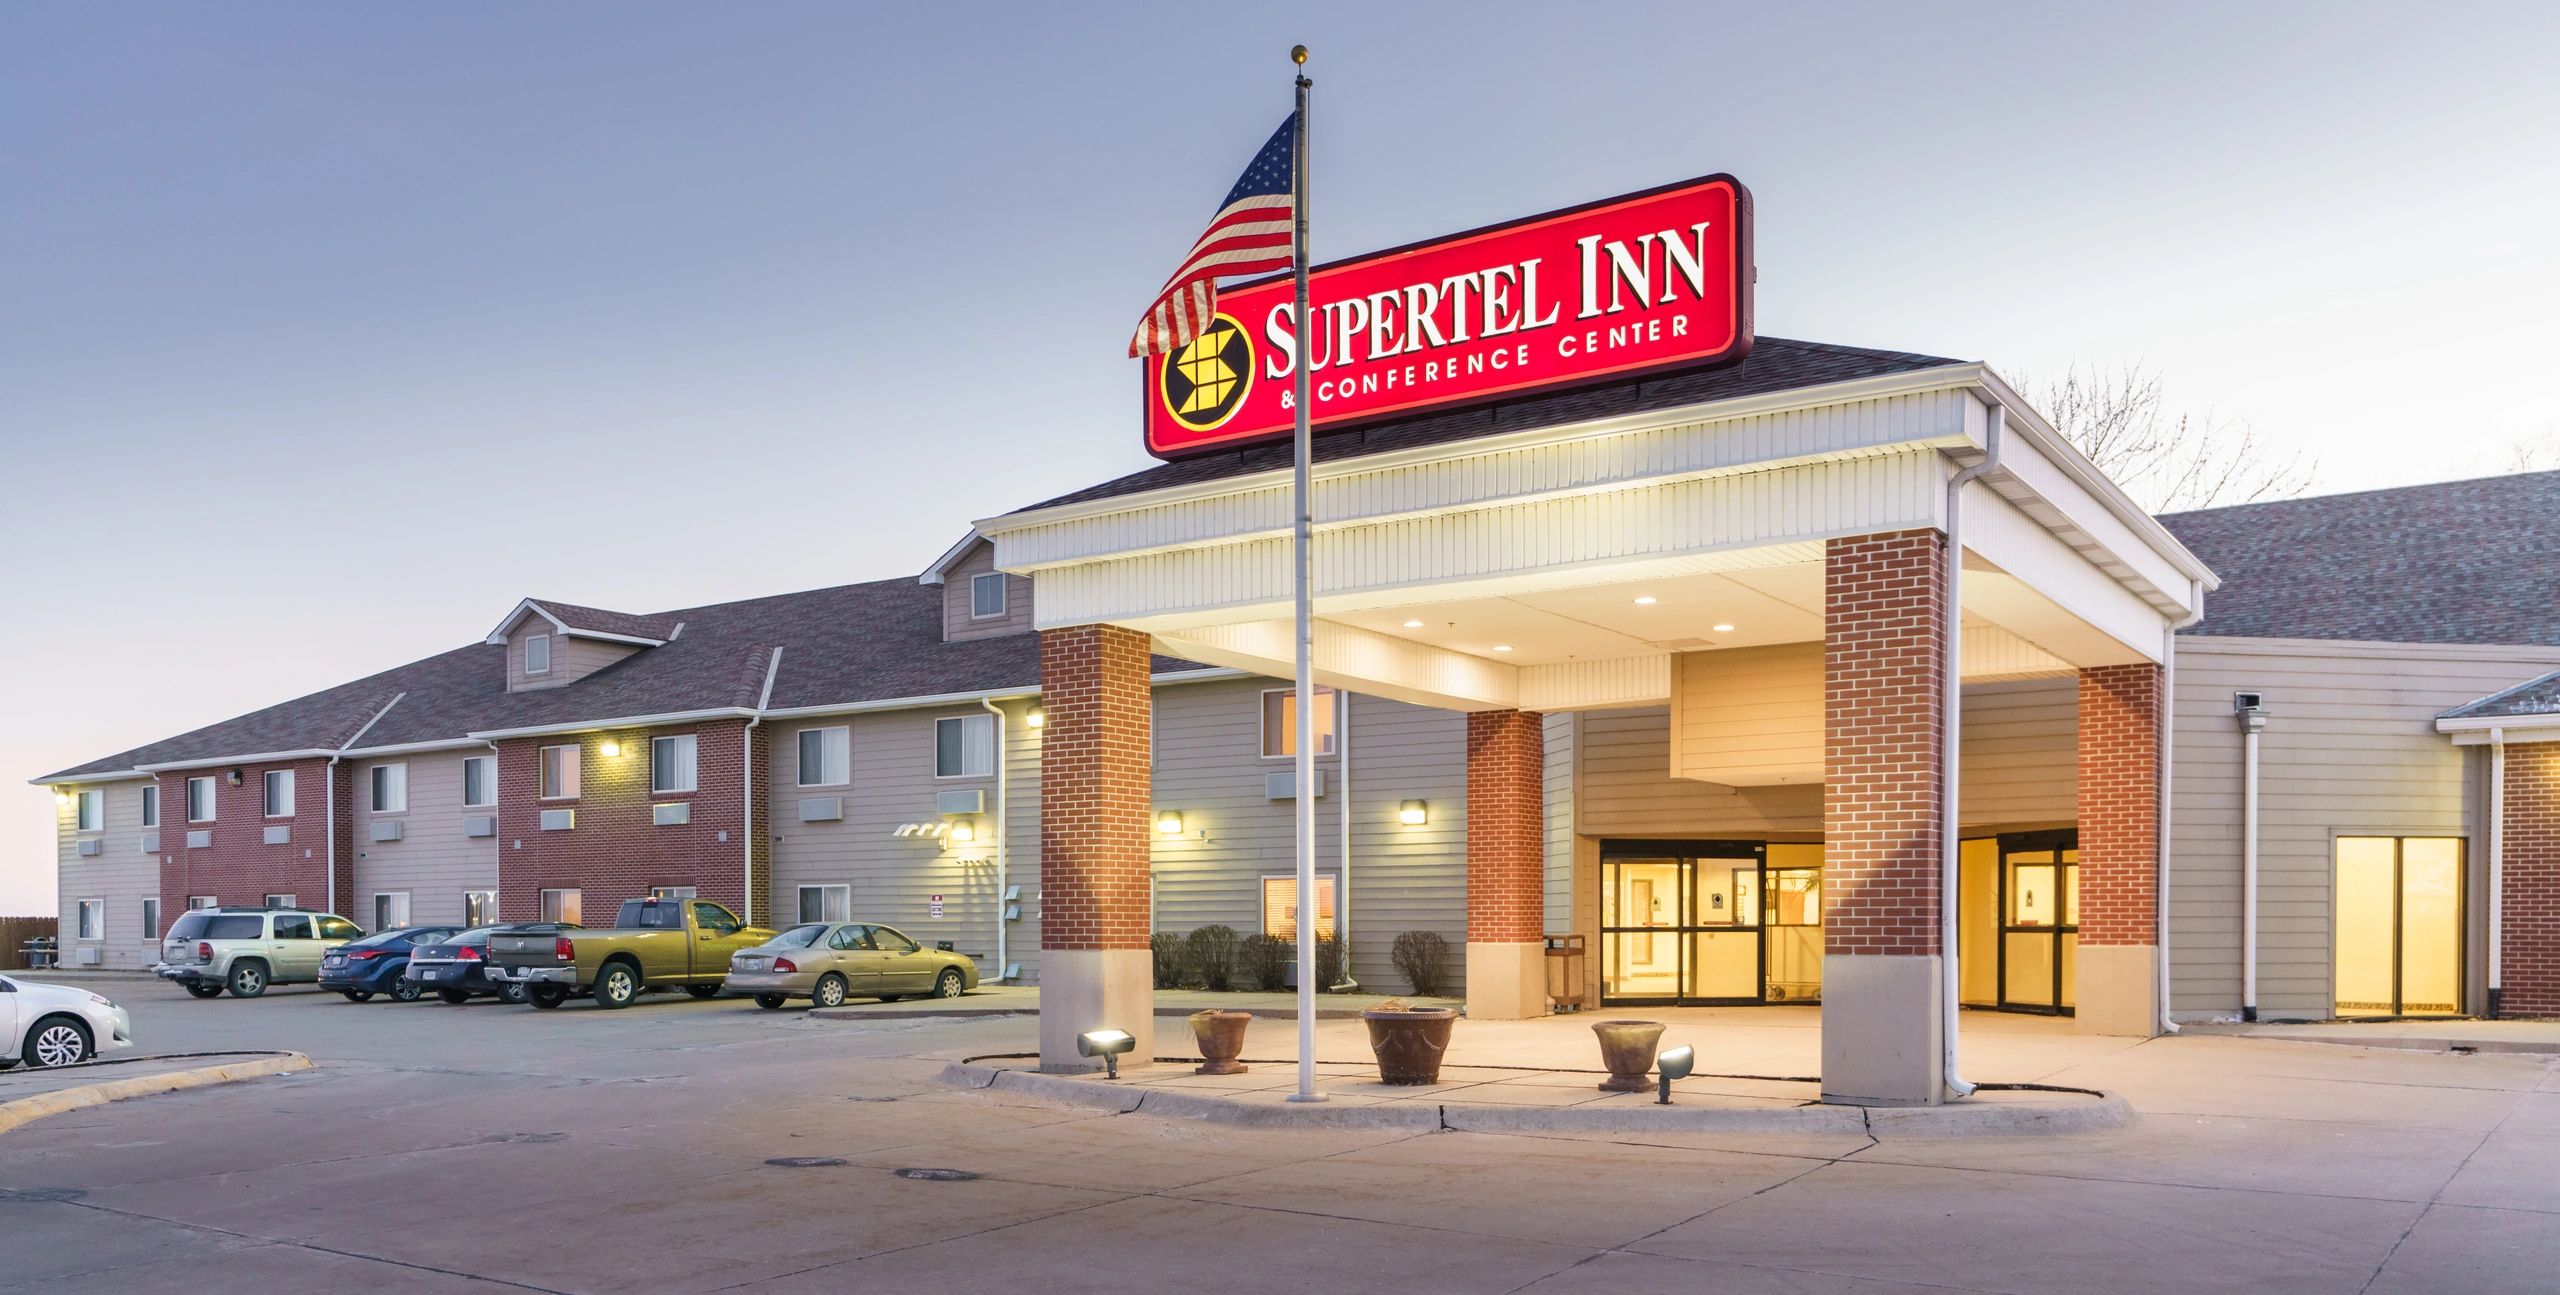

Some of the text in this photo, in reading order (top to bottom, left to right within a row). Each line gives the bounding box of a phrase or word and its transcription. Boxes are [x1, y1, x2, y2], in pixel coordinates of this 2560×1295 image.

[1266, 222, 1710, 380] SUPERTEL INN
[1281, 314, 1688, 409] & CONFERENCE CENTER
